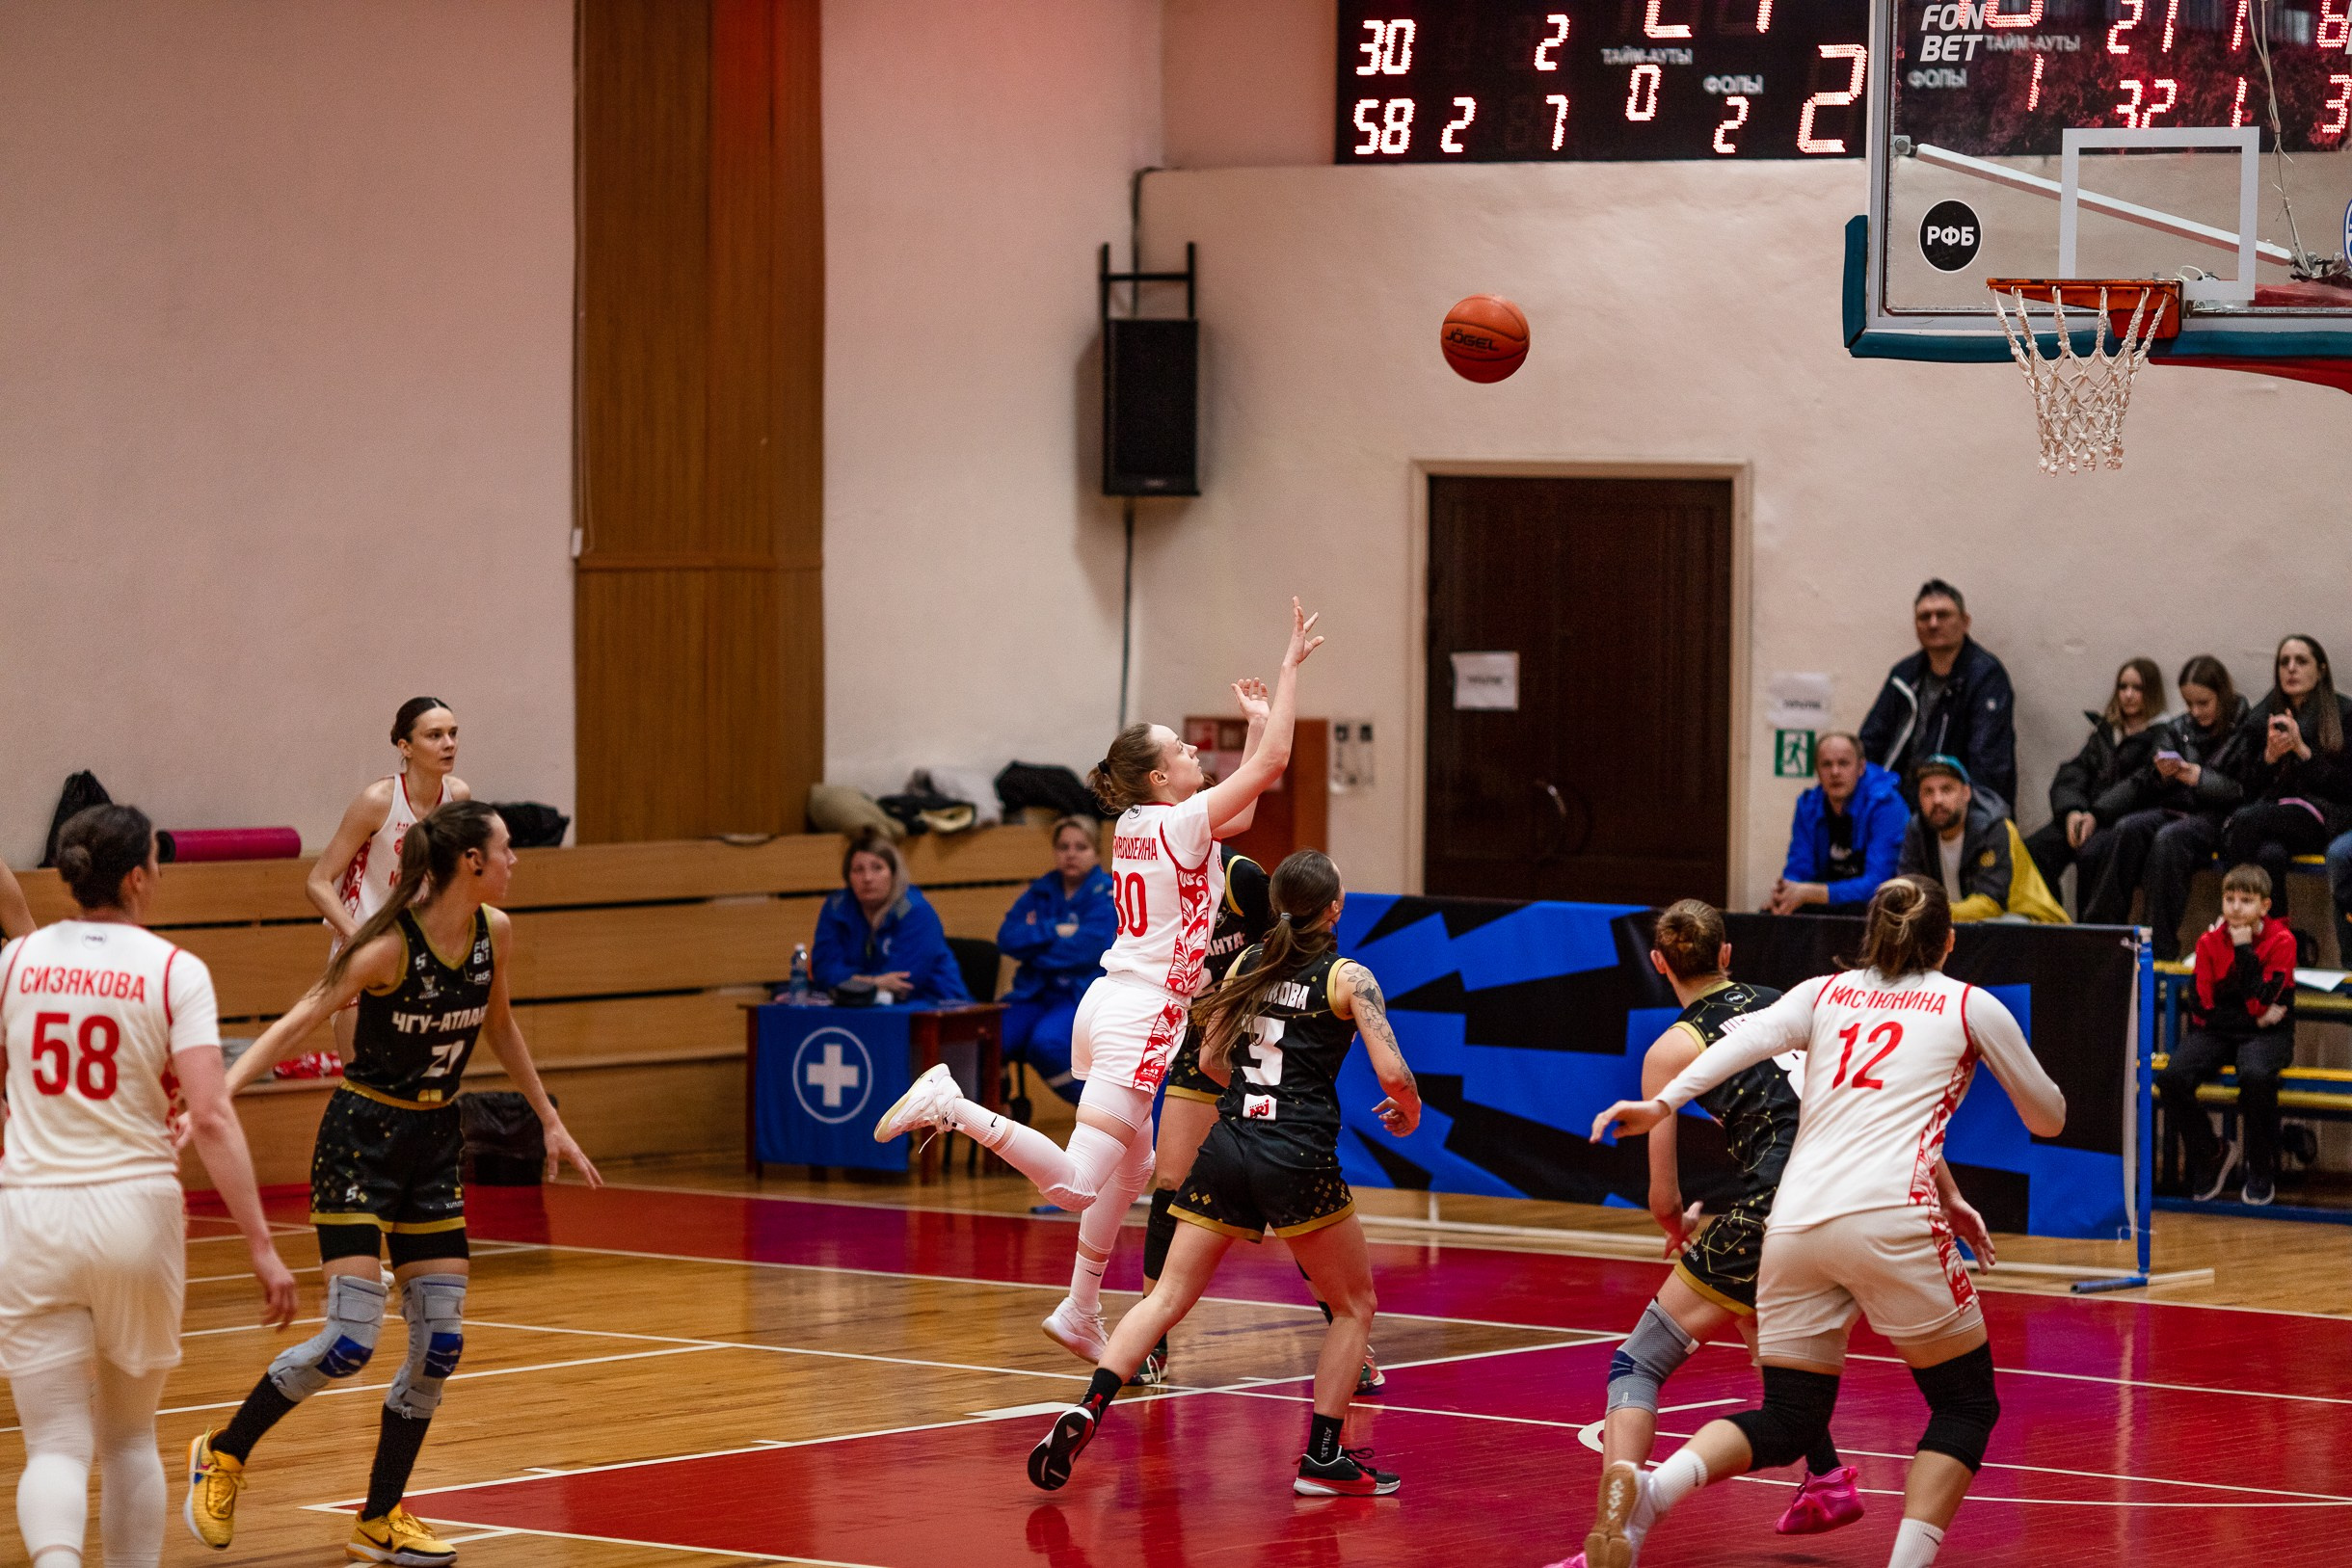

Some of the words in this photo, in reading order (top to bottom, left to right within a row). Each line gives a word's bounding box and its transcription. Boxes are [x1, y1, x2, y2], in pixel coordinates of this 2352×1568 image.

[1535, 14, 1569, 71] 2
[1920, 3, 1987, 31] FON
[1984, 34, 2080, 52] ТАЙМ-АУТЫ
[1356, 18, 1416, 75] 30
[1919, 34, 1984, 62] BET
[1625, 65, 1662, 120] 0
[1798, 44, 1867, 153] 2
[2027, 54, 2045, 112] 1
[2117, 78, 2178, 128] 32
[1352, 98, 1415, 154] 58
[1440, 96, 1477, 153] 2
[1545, 94, 1569, 150] 7
[1712, 95, 1750, 153] 2
[1927, 226, 1975, 247] РФБ
[1445, 329, 1500, 352] JÖGEL
[19, 966, 145, 1003] СИЗЯКОВА
[32, 1012, 120, 1101] 58
[1240, 1014, 1286, 1086] 3
[1832, 1021, 1904, 1090] 12
